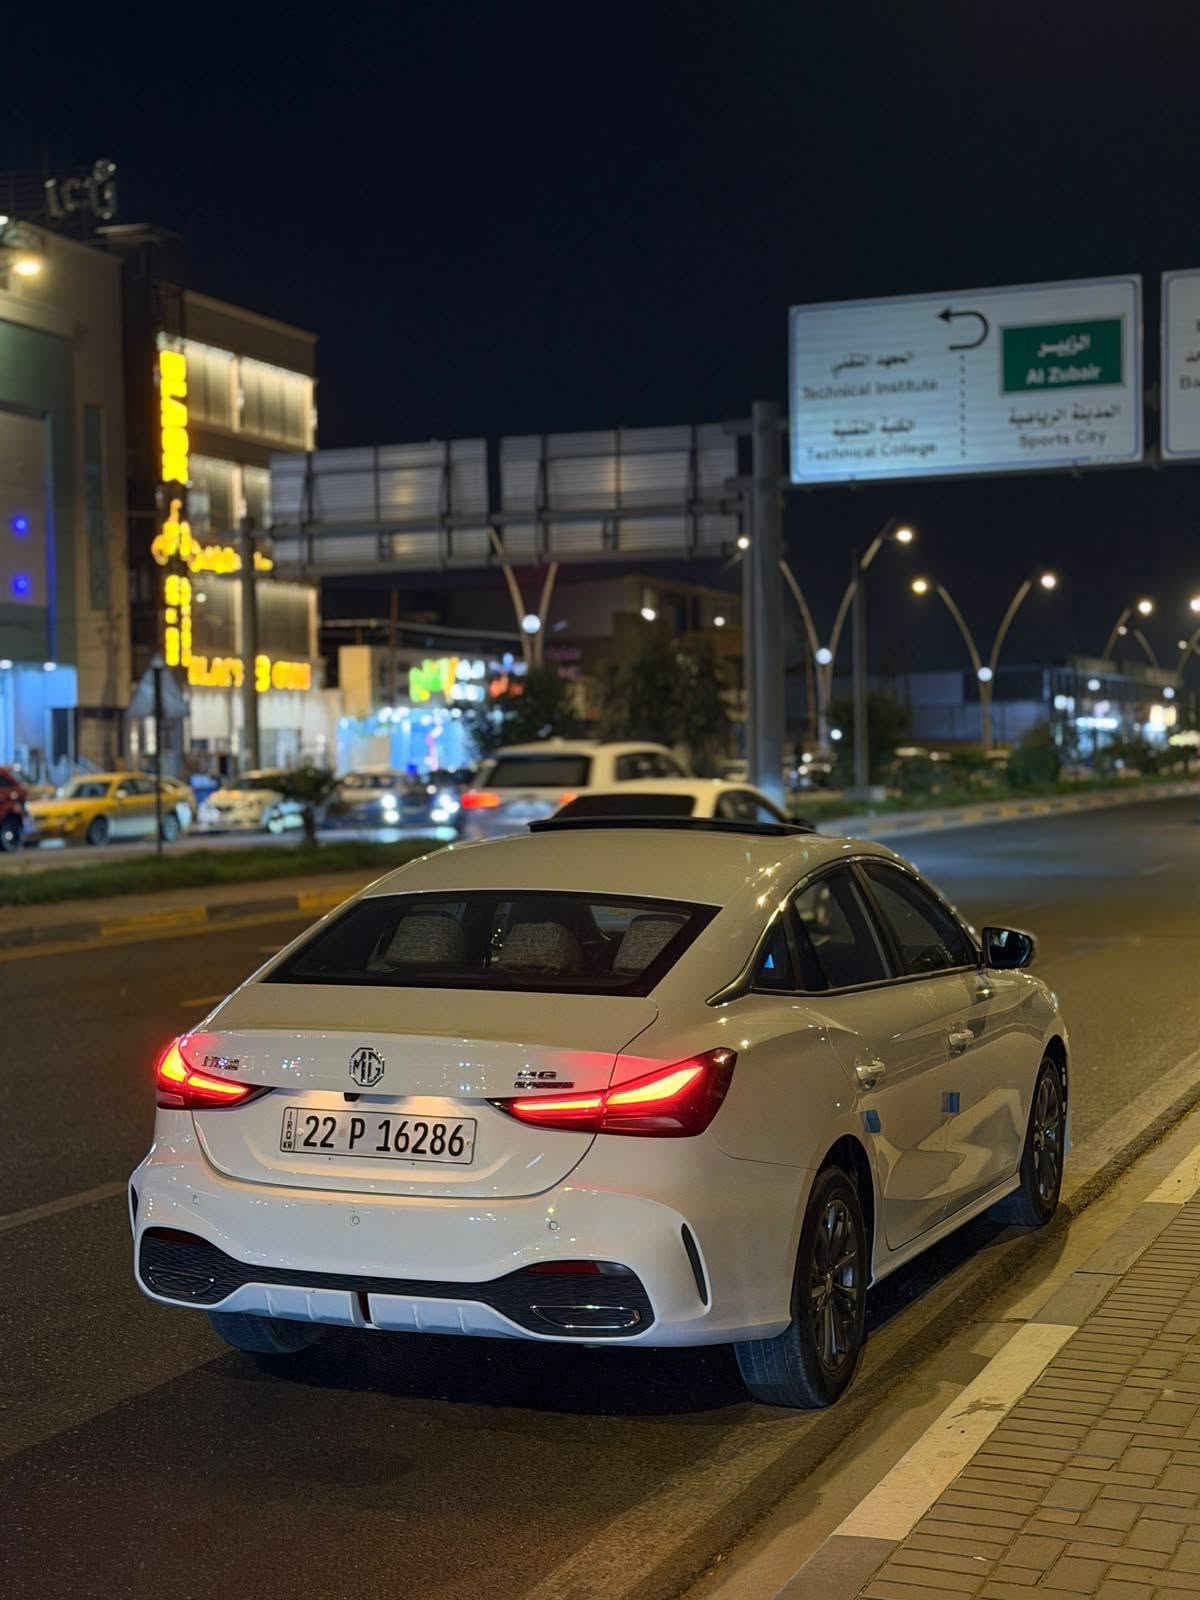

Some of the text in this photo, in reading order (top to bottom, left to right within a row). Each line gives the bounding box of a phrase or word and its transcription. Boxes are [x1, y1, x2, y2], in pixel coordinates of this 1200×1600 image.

[1026, 362, 1101, 385] Al Zubair
[803, 379, 938, 402] Technical Institute
[806, 441, 937, 461] Technical College
[1018, 430, 1107, 450] Sports City
[350, 1049, 384, 1086] MG
[303, 1115, 466, 1157] 22 P 16286
